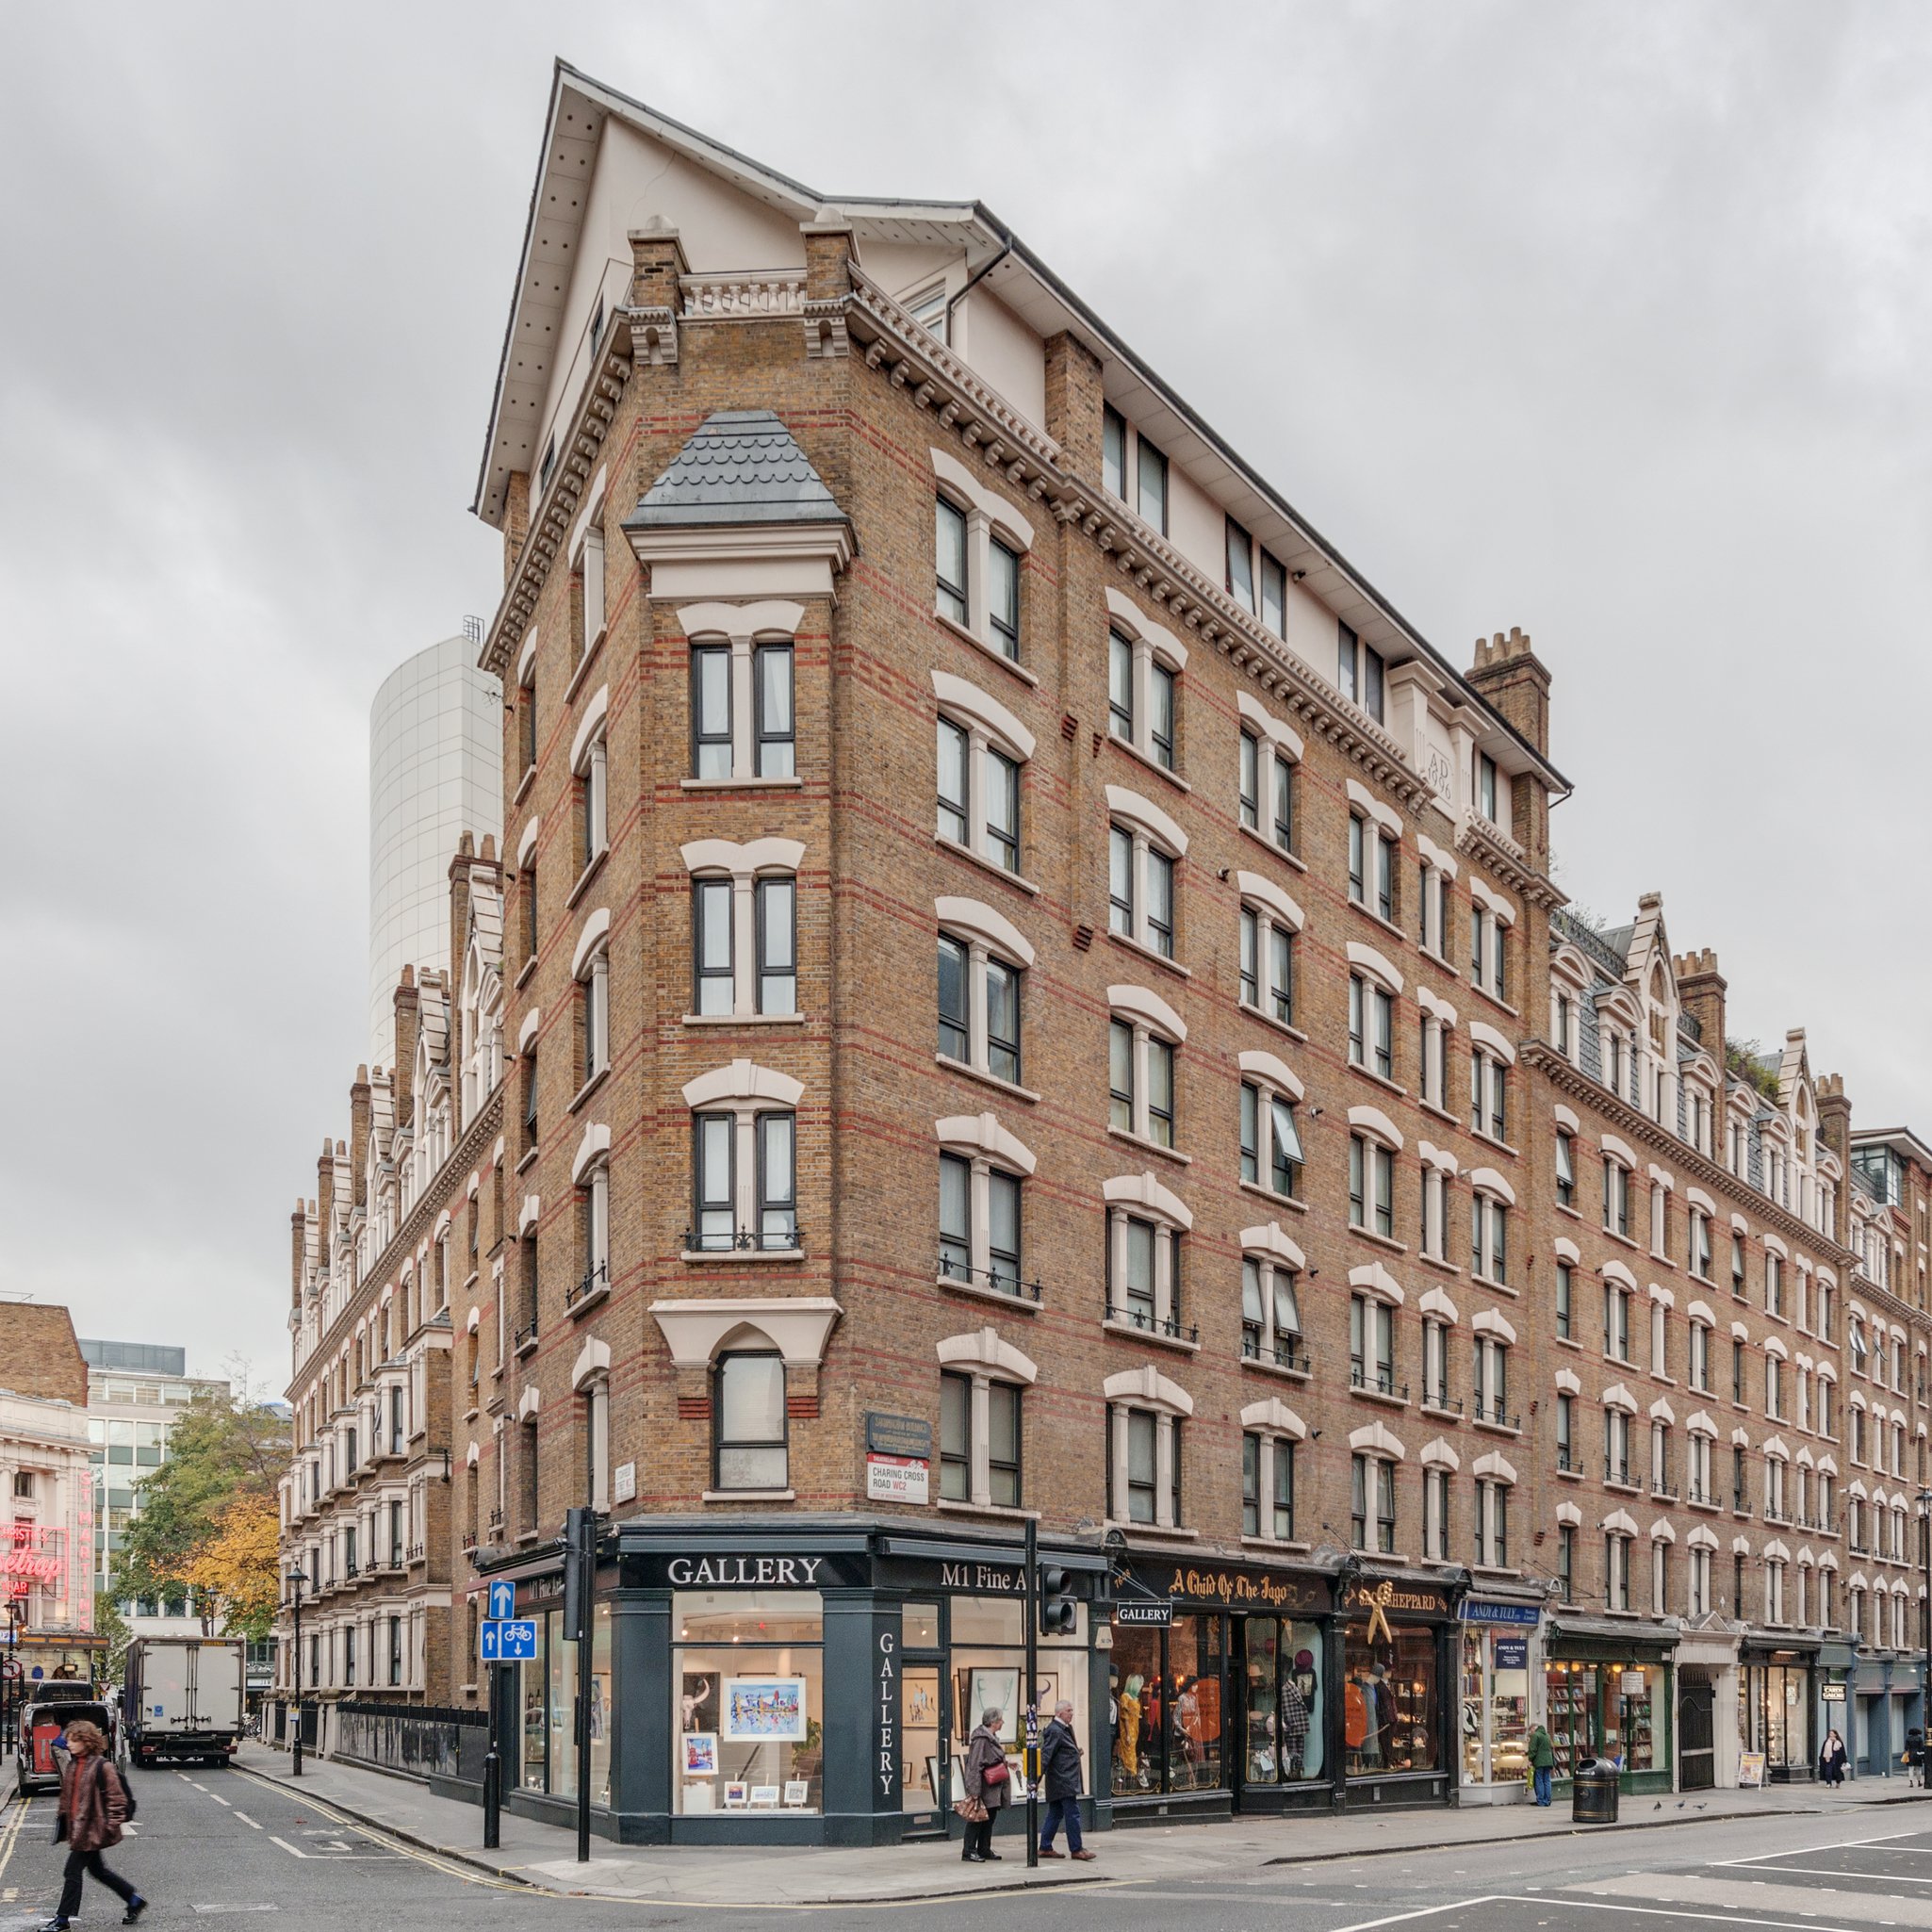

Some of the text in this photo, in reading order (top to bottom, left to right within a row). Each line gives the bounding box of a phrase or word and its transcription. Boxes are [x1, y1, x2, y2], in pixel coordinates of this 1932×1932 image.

[873, 1467, 925, 1482] CHARING CROSS
[873, 1478, 907, 1491] ROAD WC2
[667, 1558, 823, 1584] GALLERY
[941, 1563, 970, 1587] M1
[975, 1564, 1010, 1590] Fine
[1168, 1568, 1286, 1606] A Child Of The Jago
[1120, 1609, 1169, 1621] GALLERY
[1472, 1605, 1492, 1618] ANDY
[1491, 1605, 1499, 1618] &
[879, 1633, 894, 1794] GALLERY
